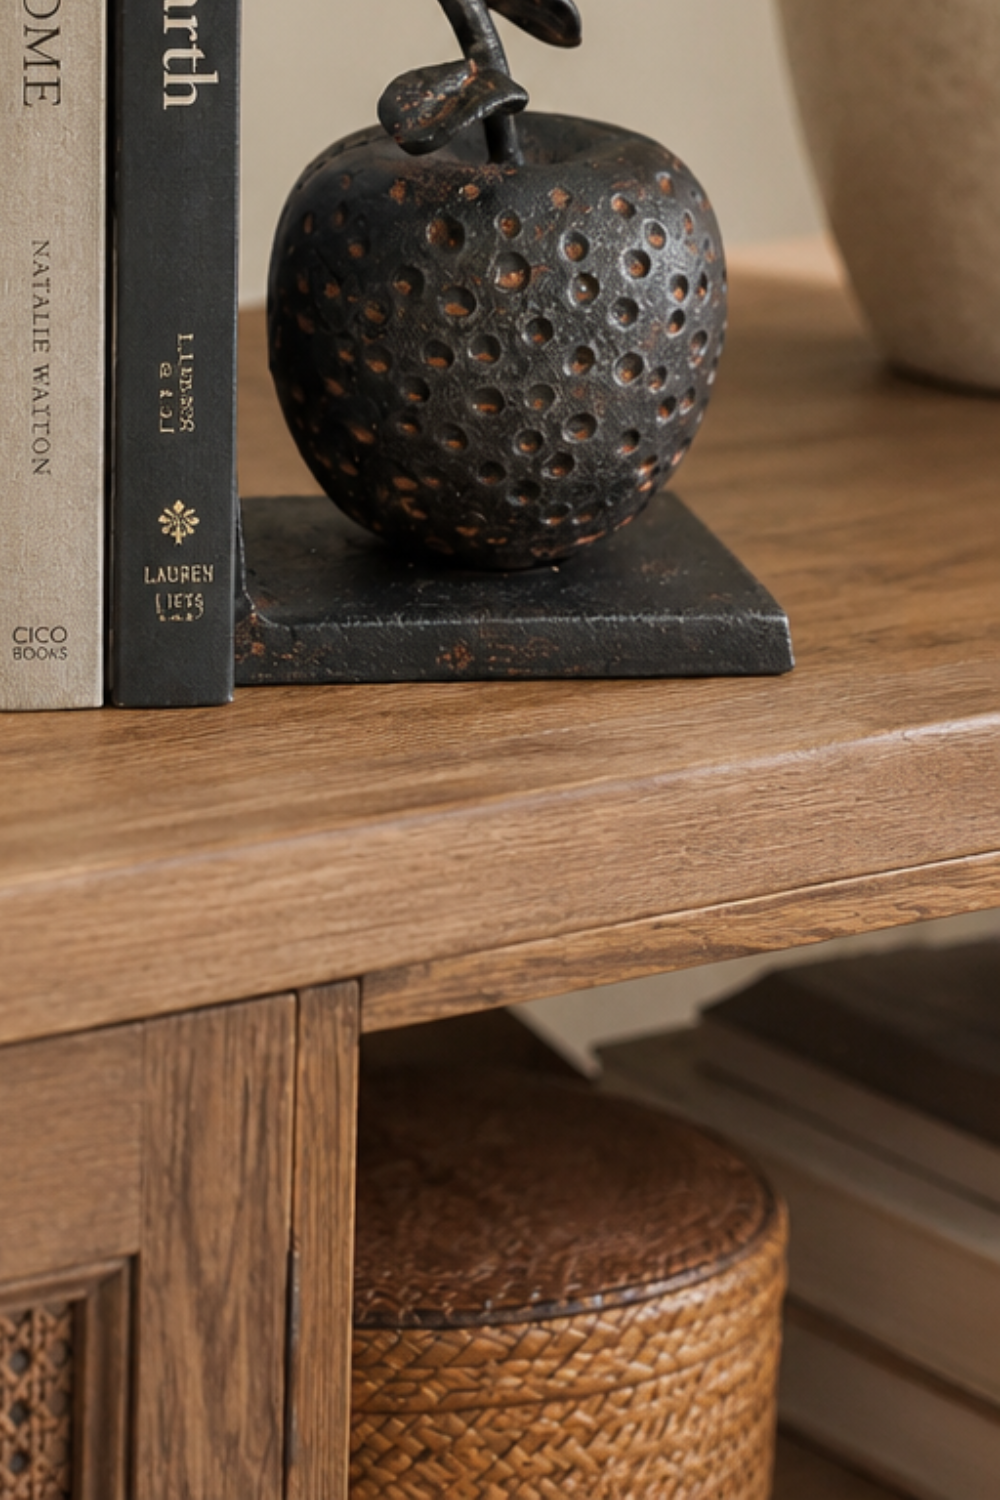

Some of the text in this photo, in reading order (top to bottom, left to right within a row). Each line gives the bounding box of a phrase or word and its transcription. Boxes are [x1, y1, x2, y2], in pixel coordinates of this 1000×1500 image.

[31, 240, 51, 353] NATALIE
[11, 625, 68, 644] CICO
[12, 646, 68, 661] BOOKS
